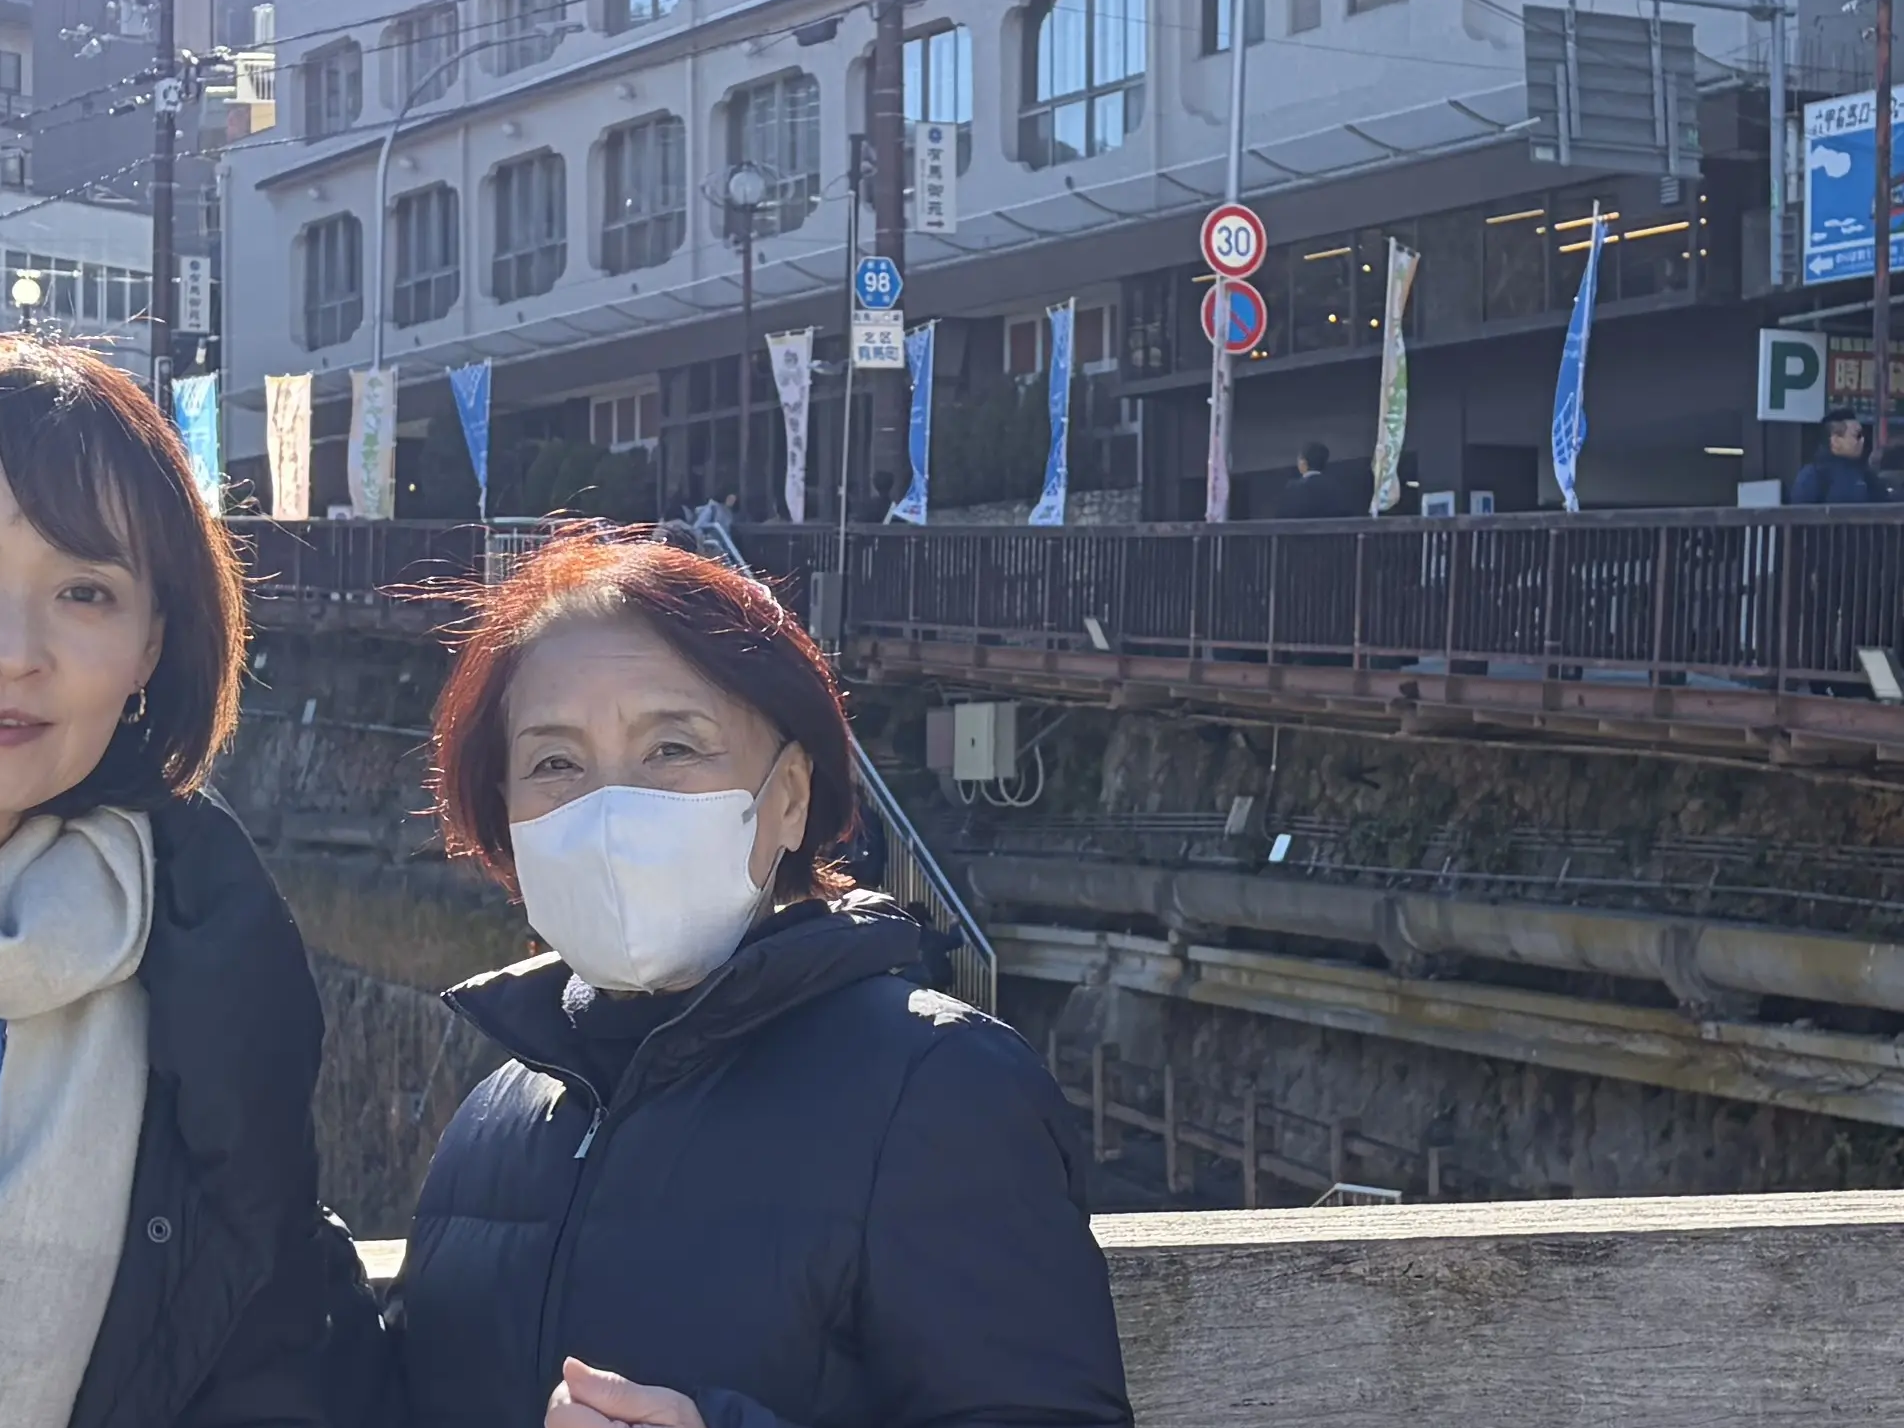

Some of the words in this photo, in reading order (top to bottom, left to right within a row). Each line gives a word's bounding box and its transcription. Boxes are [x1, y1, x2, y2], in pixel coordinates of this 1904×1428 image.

[1217, 225, 1251, 257] 30
[864, 272, 891, 293] 98
[1769, 341, 1820, 410] P
